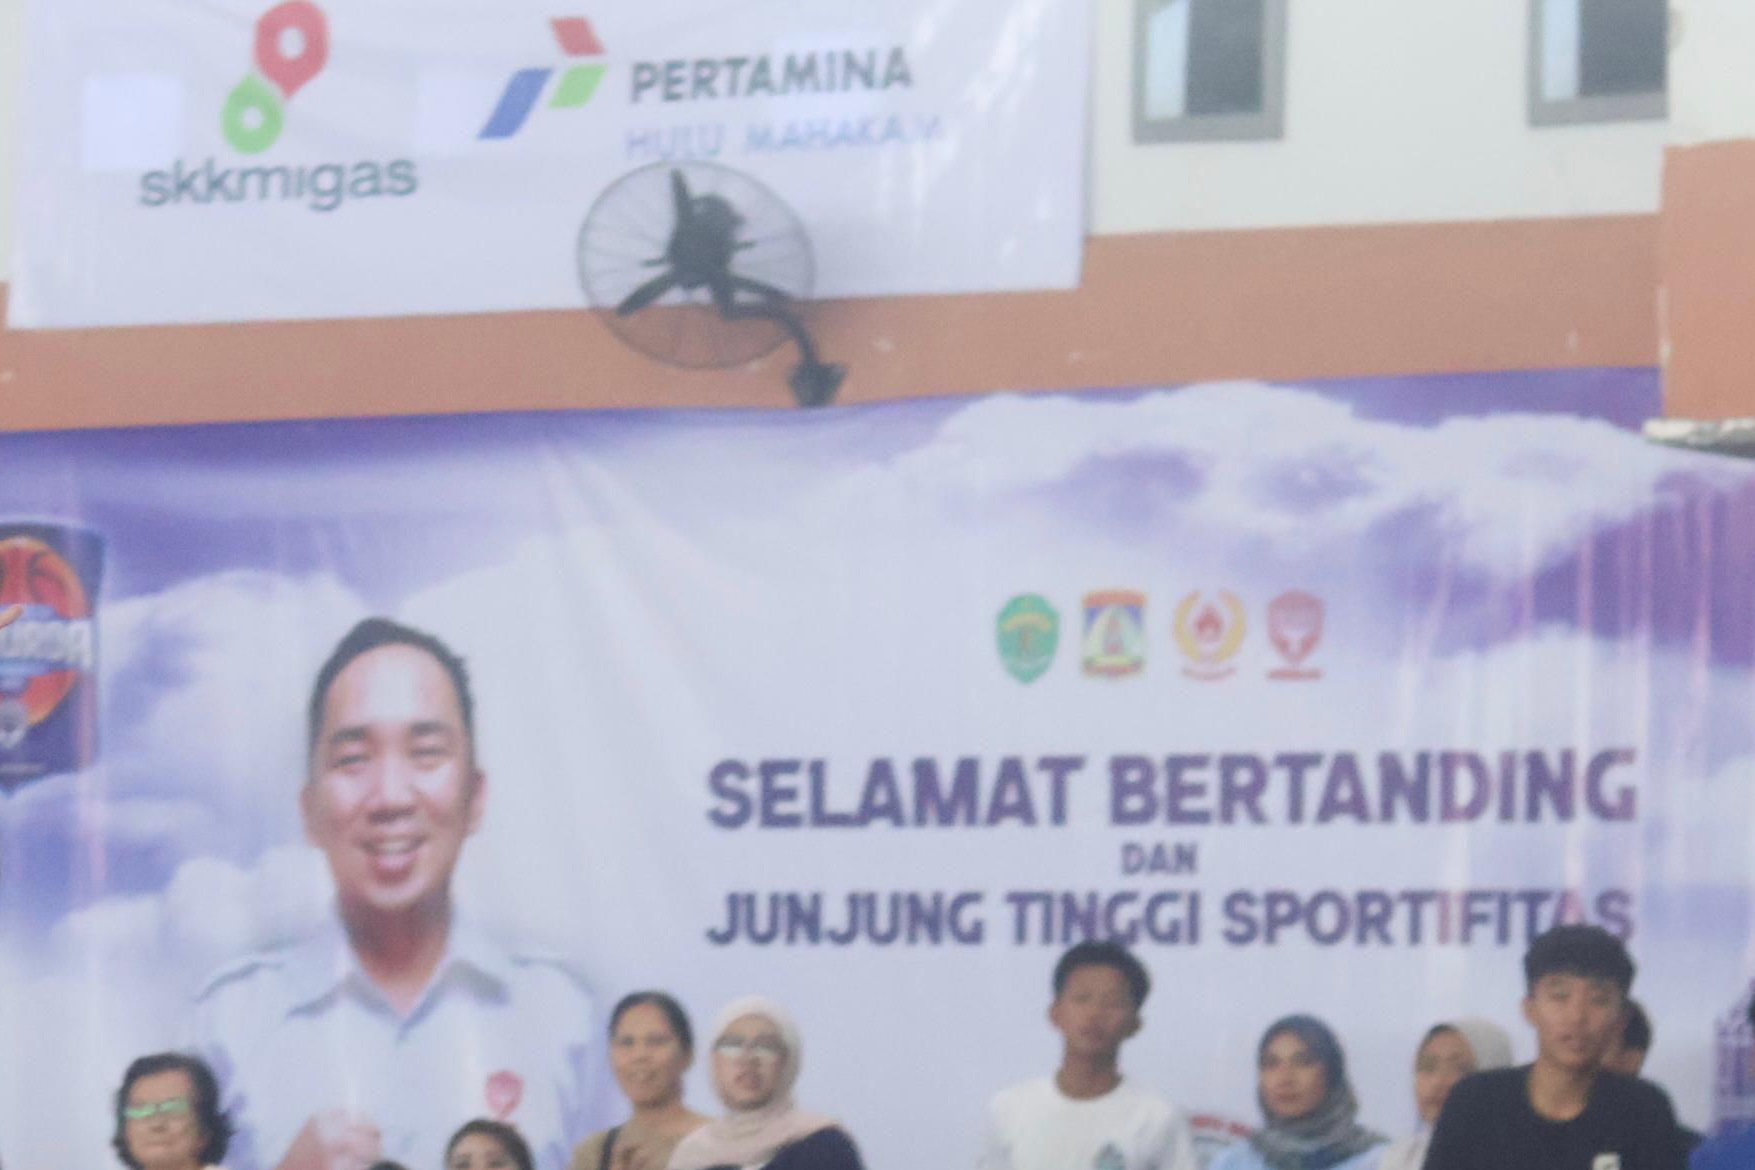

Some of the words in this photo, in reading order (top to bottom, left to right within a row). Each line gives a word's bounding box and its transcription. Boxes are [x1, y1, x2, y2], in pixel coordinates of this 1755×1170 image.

[629, 46, 914, 104] PERTAMINA
[138, 158, 419, 212] skkmigas
[706, 754, 1087, 829] SELAMAT
[1107, 748, 1638, 826] BERTANDING
[1119, 842, 1198, 876] DAN
[705, 891, 987, 946] JUNJUNG
[1004, 890, 1201, 946] TINGGI
